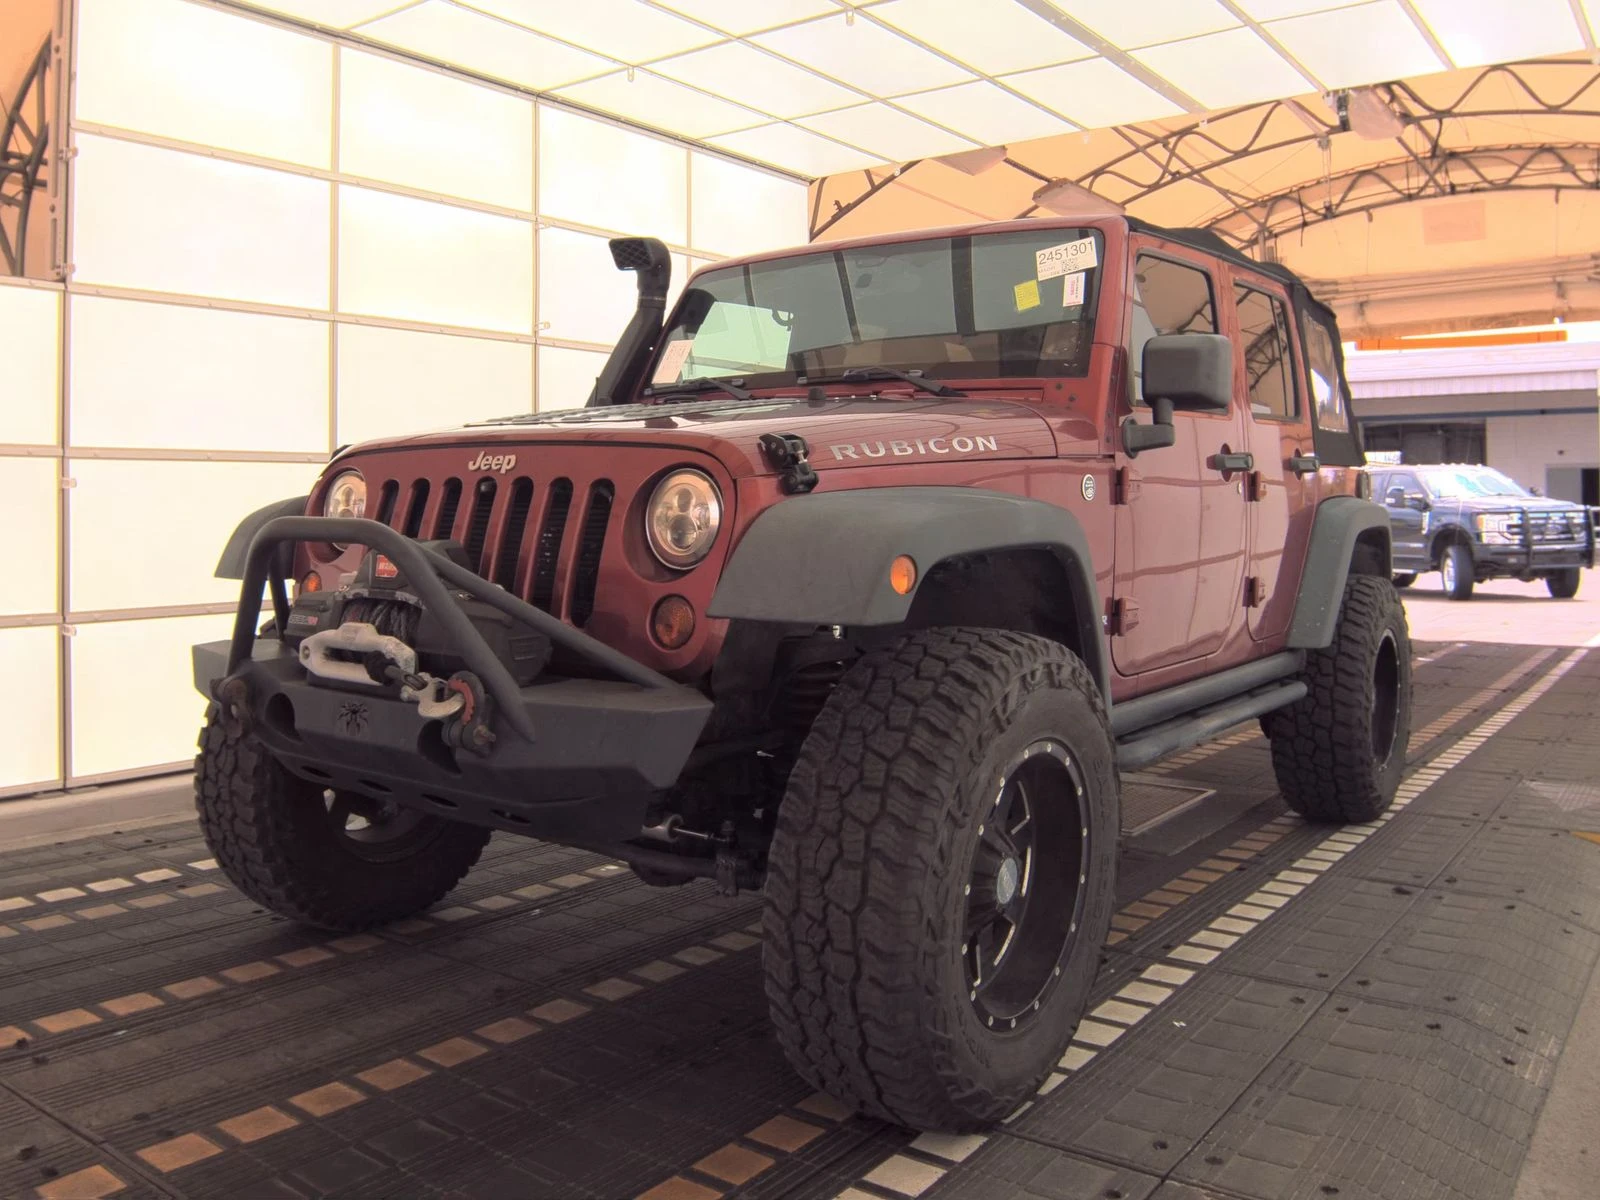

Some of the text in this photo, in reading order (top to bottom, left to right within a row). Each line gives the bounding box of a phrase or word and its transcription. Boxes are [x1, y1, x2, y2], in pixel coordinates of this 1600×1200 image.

[1038, 240, 1094, 265] 2451301
[829, 435, 998, 460] RUBICON
[468, 450, 516, 474] Jeep
